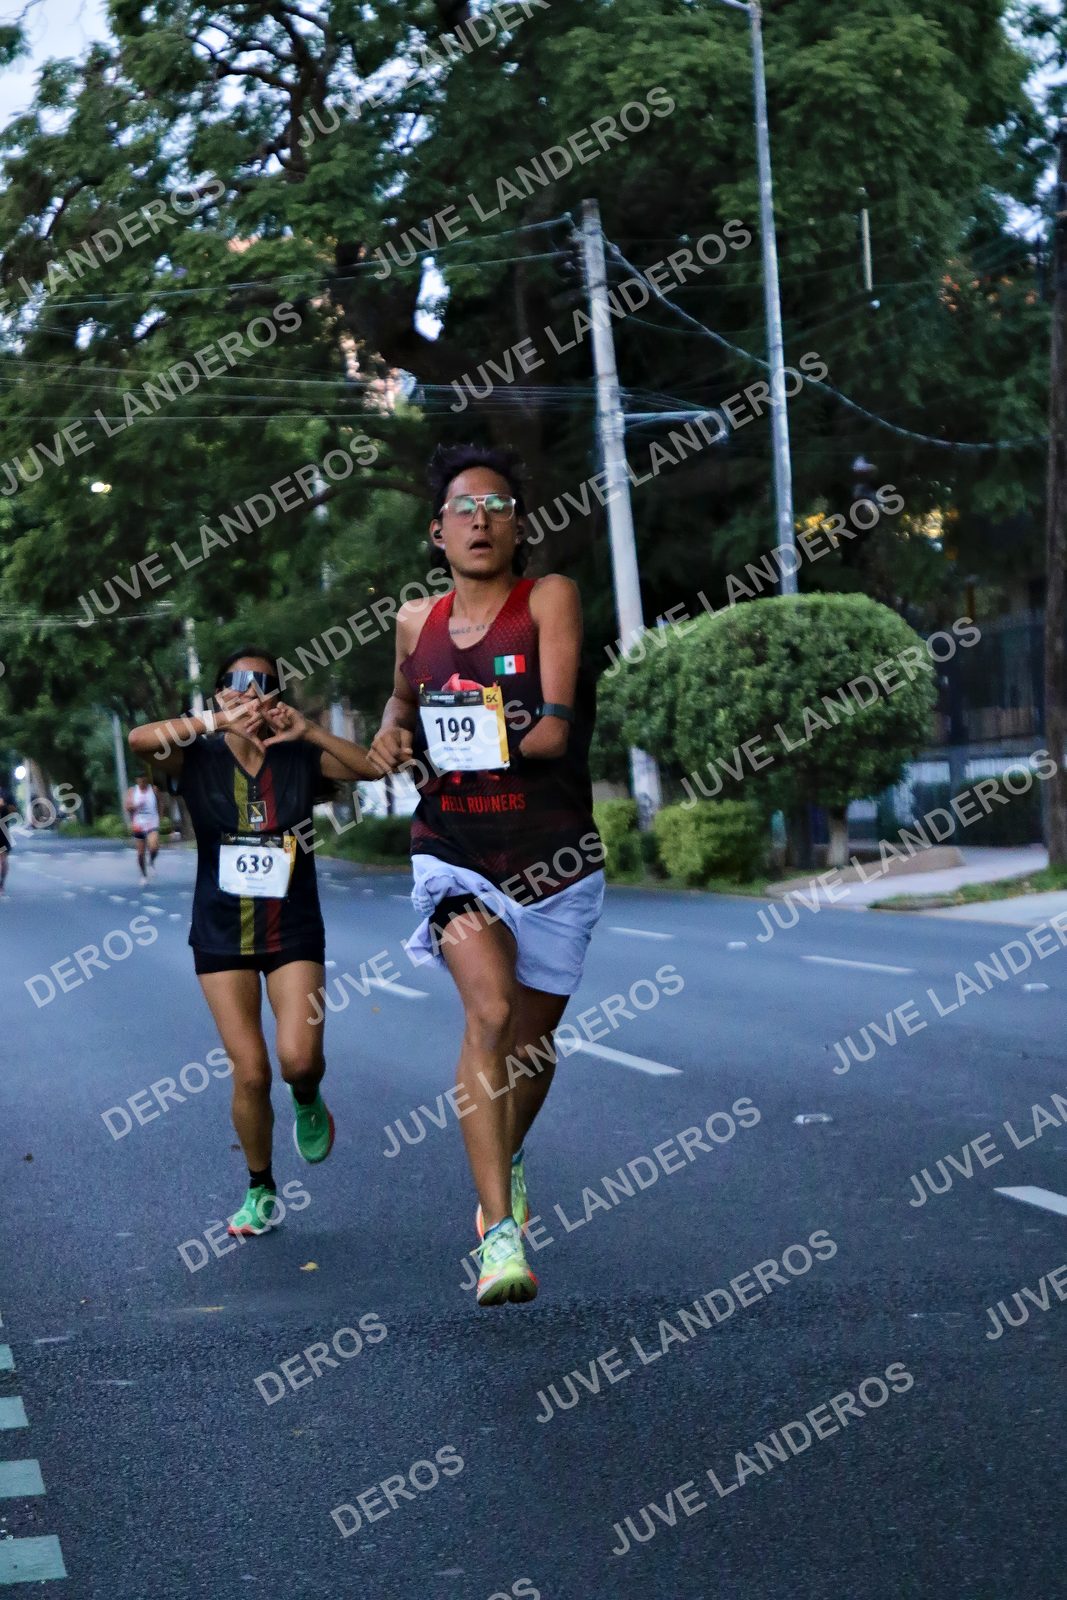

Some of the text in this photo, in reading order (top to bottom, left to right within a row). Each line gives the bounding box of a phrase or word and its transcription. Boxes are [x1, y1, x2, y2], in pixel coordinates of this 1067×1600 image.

[435, 716, 476, 742] 199
[441, 794, 465, 813] HELL
[236, 853, 274, 875] 639
